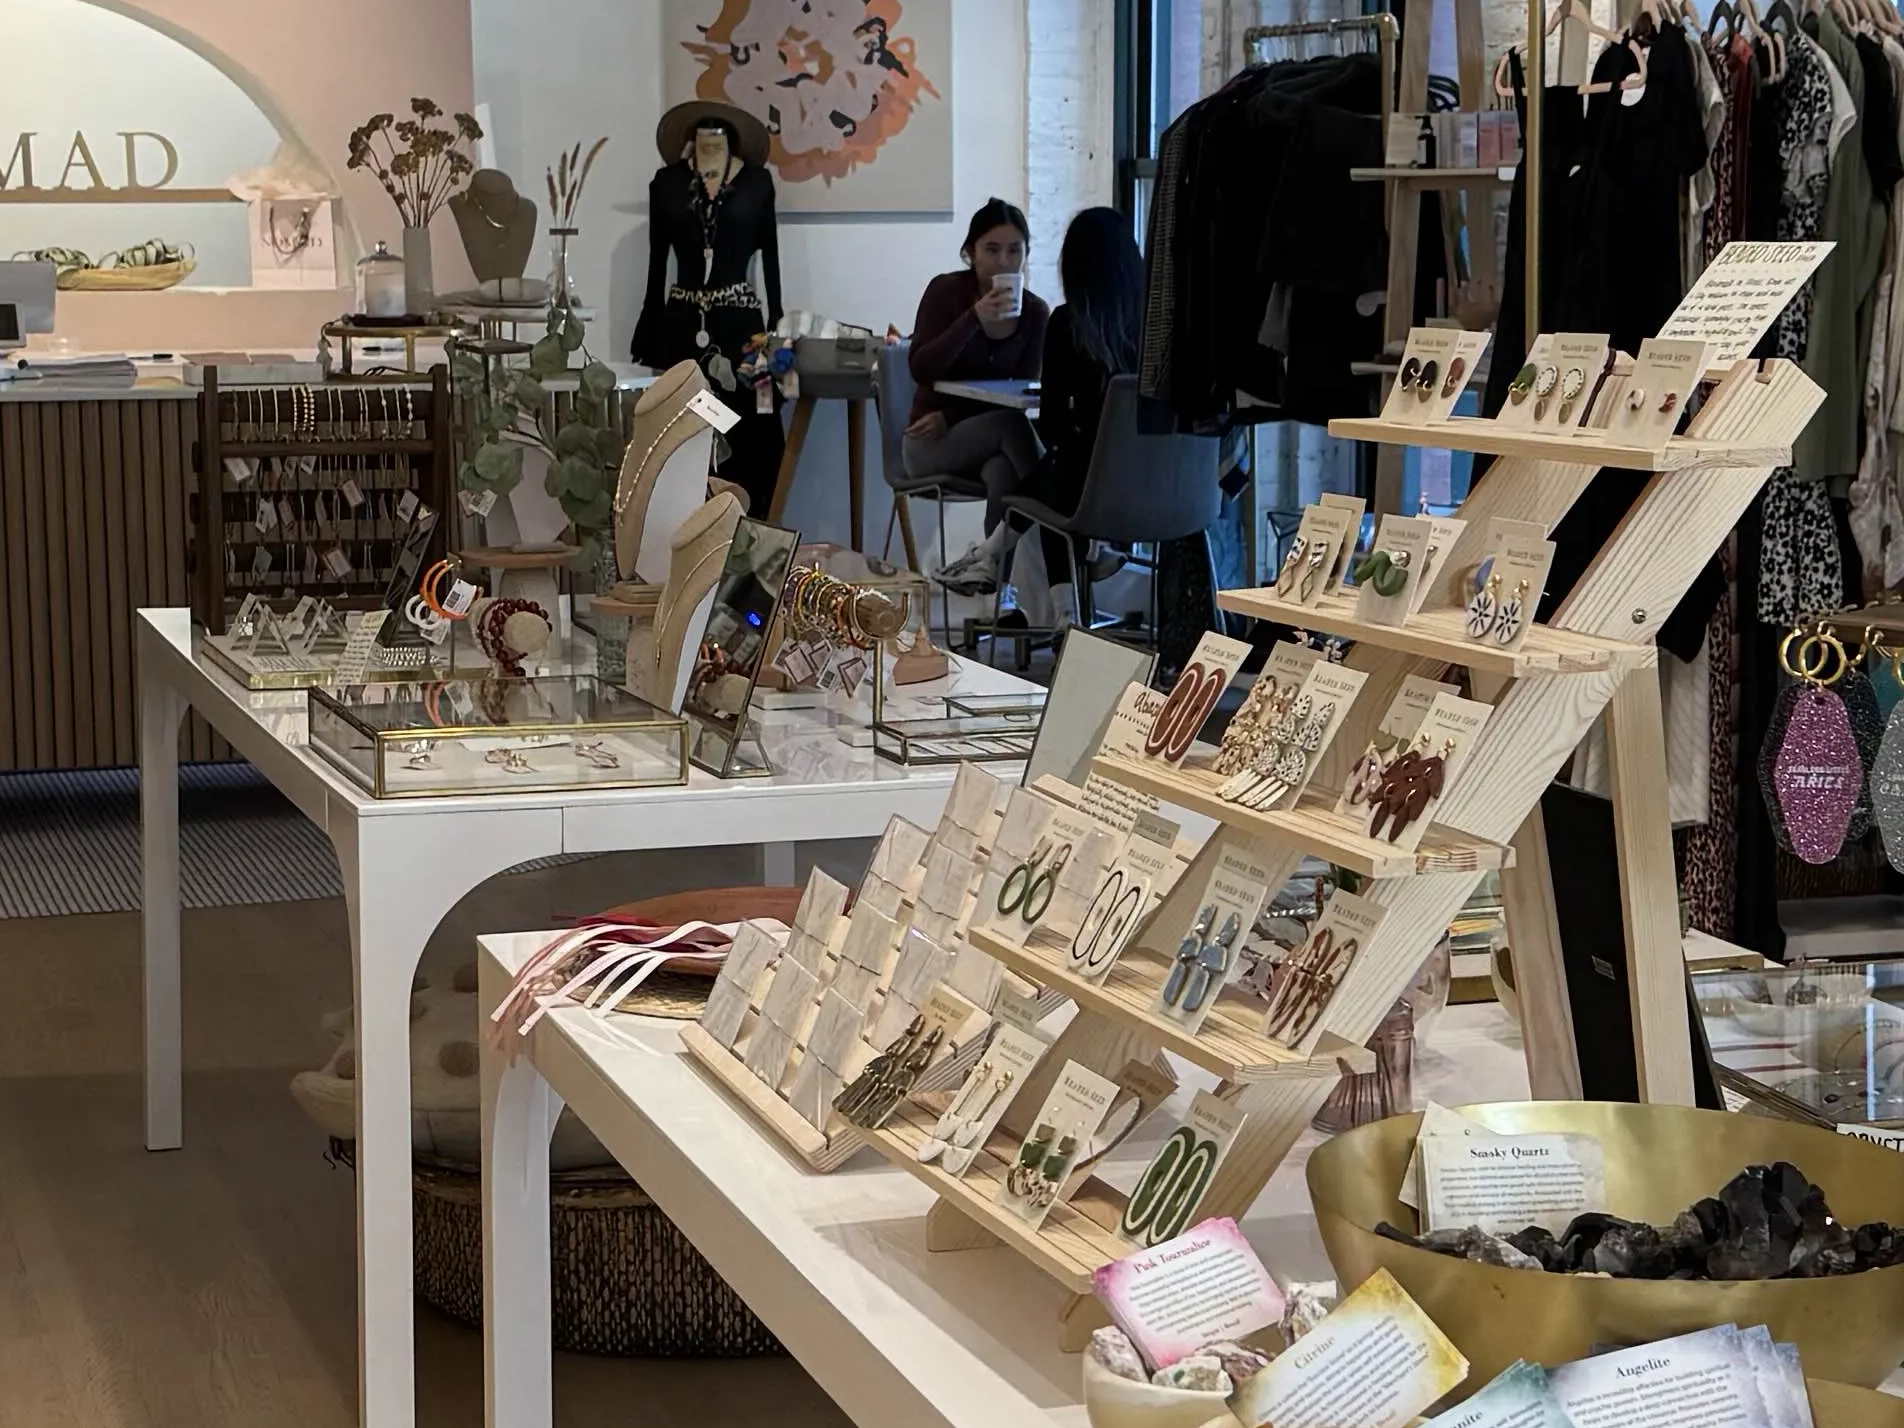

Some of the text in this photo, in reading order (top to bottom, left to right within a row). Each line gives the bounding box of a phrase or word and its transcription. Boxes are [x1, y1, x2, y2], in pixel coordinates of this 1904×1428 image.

[1470, 1146, 1550, 1160] Smoky Quartz
[1294, 1335, 1337, 1370] Citrine
[1615, 1357, 1671, 1380] Angelite
